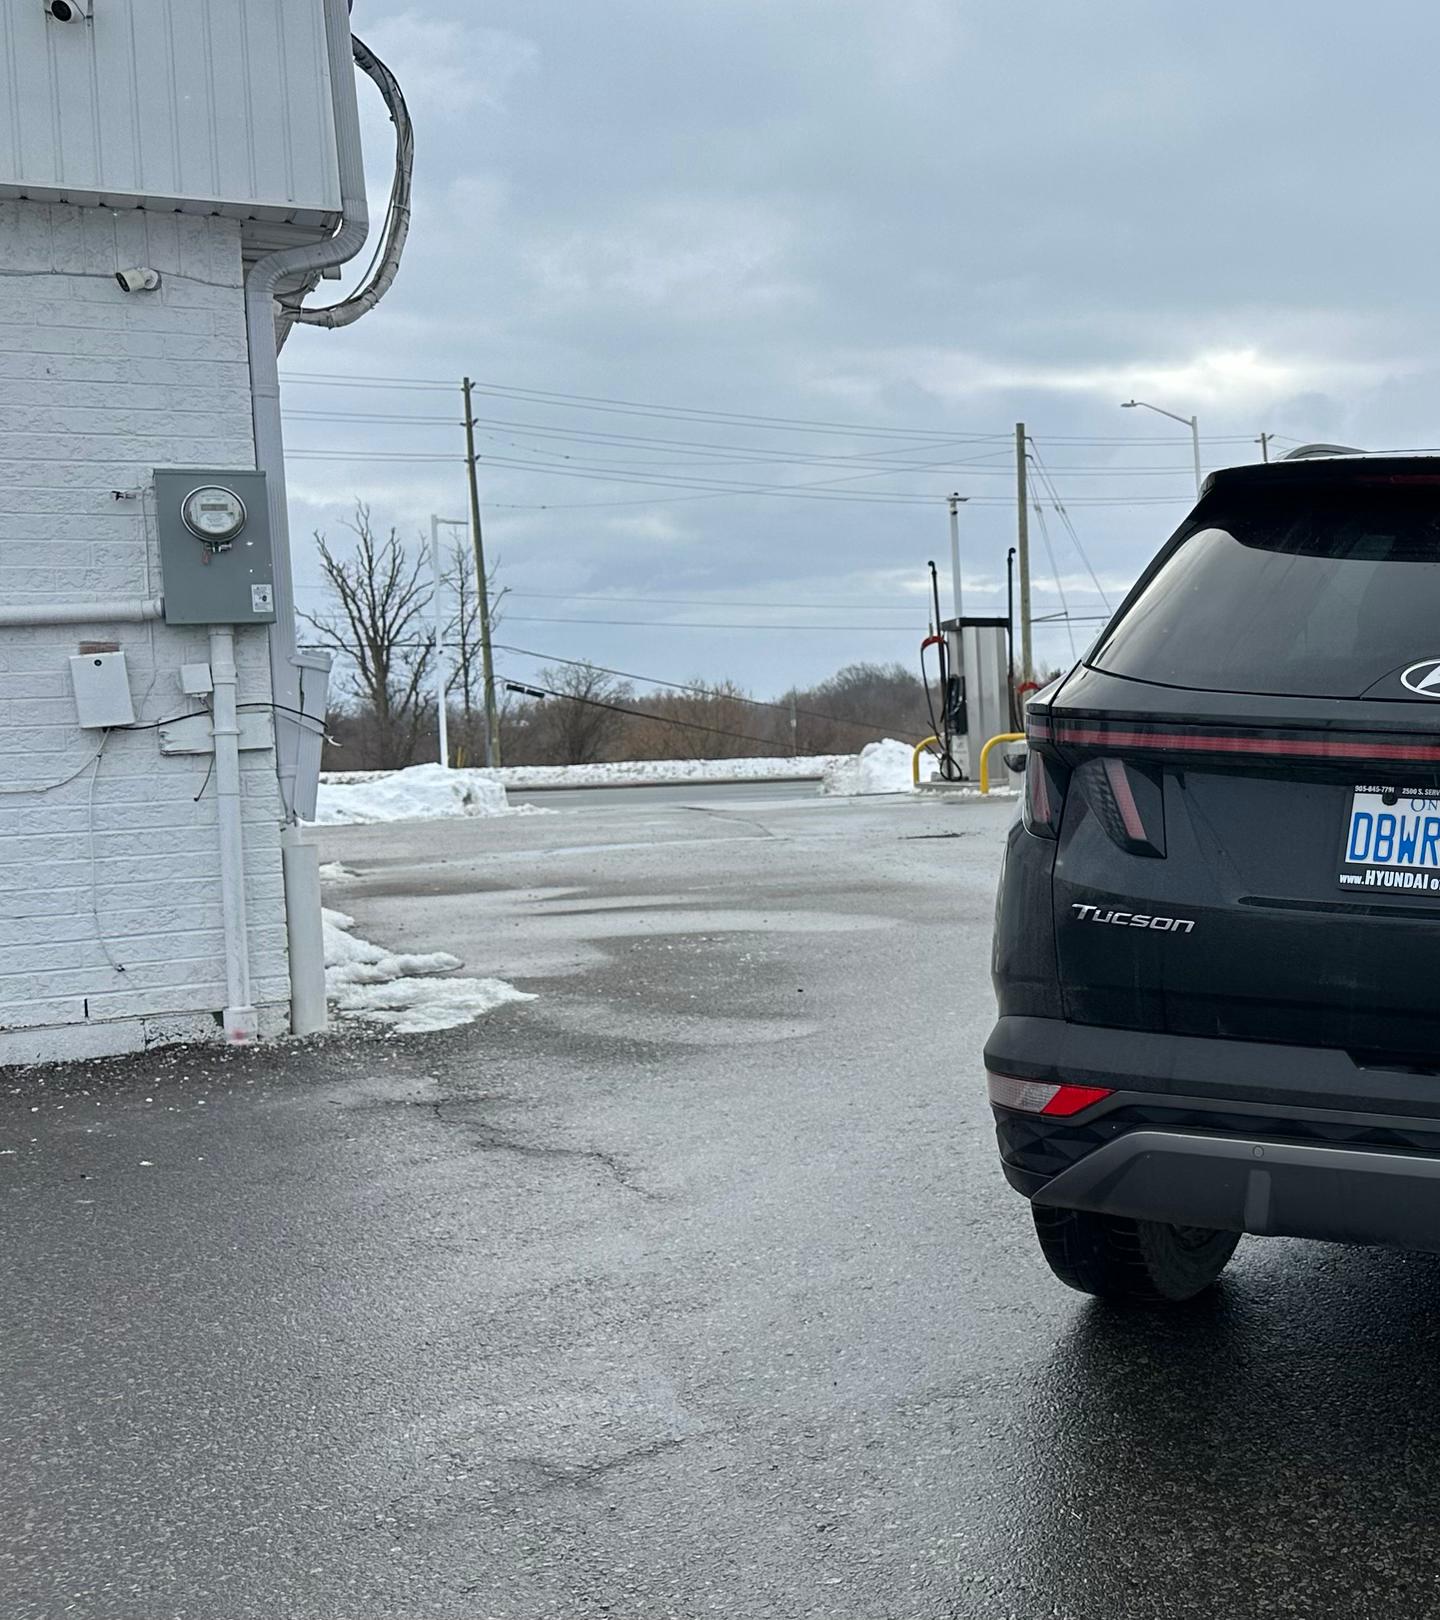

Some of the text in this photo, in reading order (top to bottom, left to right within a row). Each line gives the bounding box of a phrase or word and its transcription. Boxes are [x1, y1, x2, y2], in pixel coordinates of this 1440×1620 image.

[1402, 787, 1417, 795] 2500
[1339, 870, 1429, 890] www.HYUNDAI
[1071, 903, 1195, 933] Tucson
